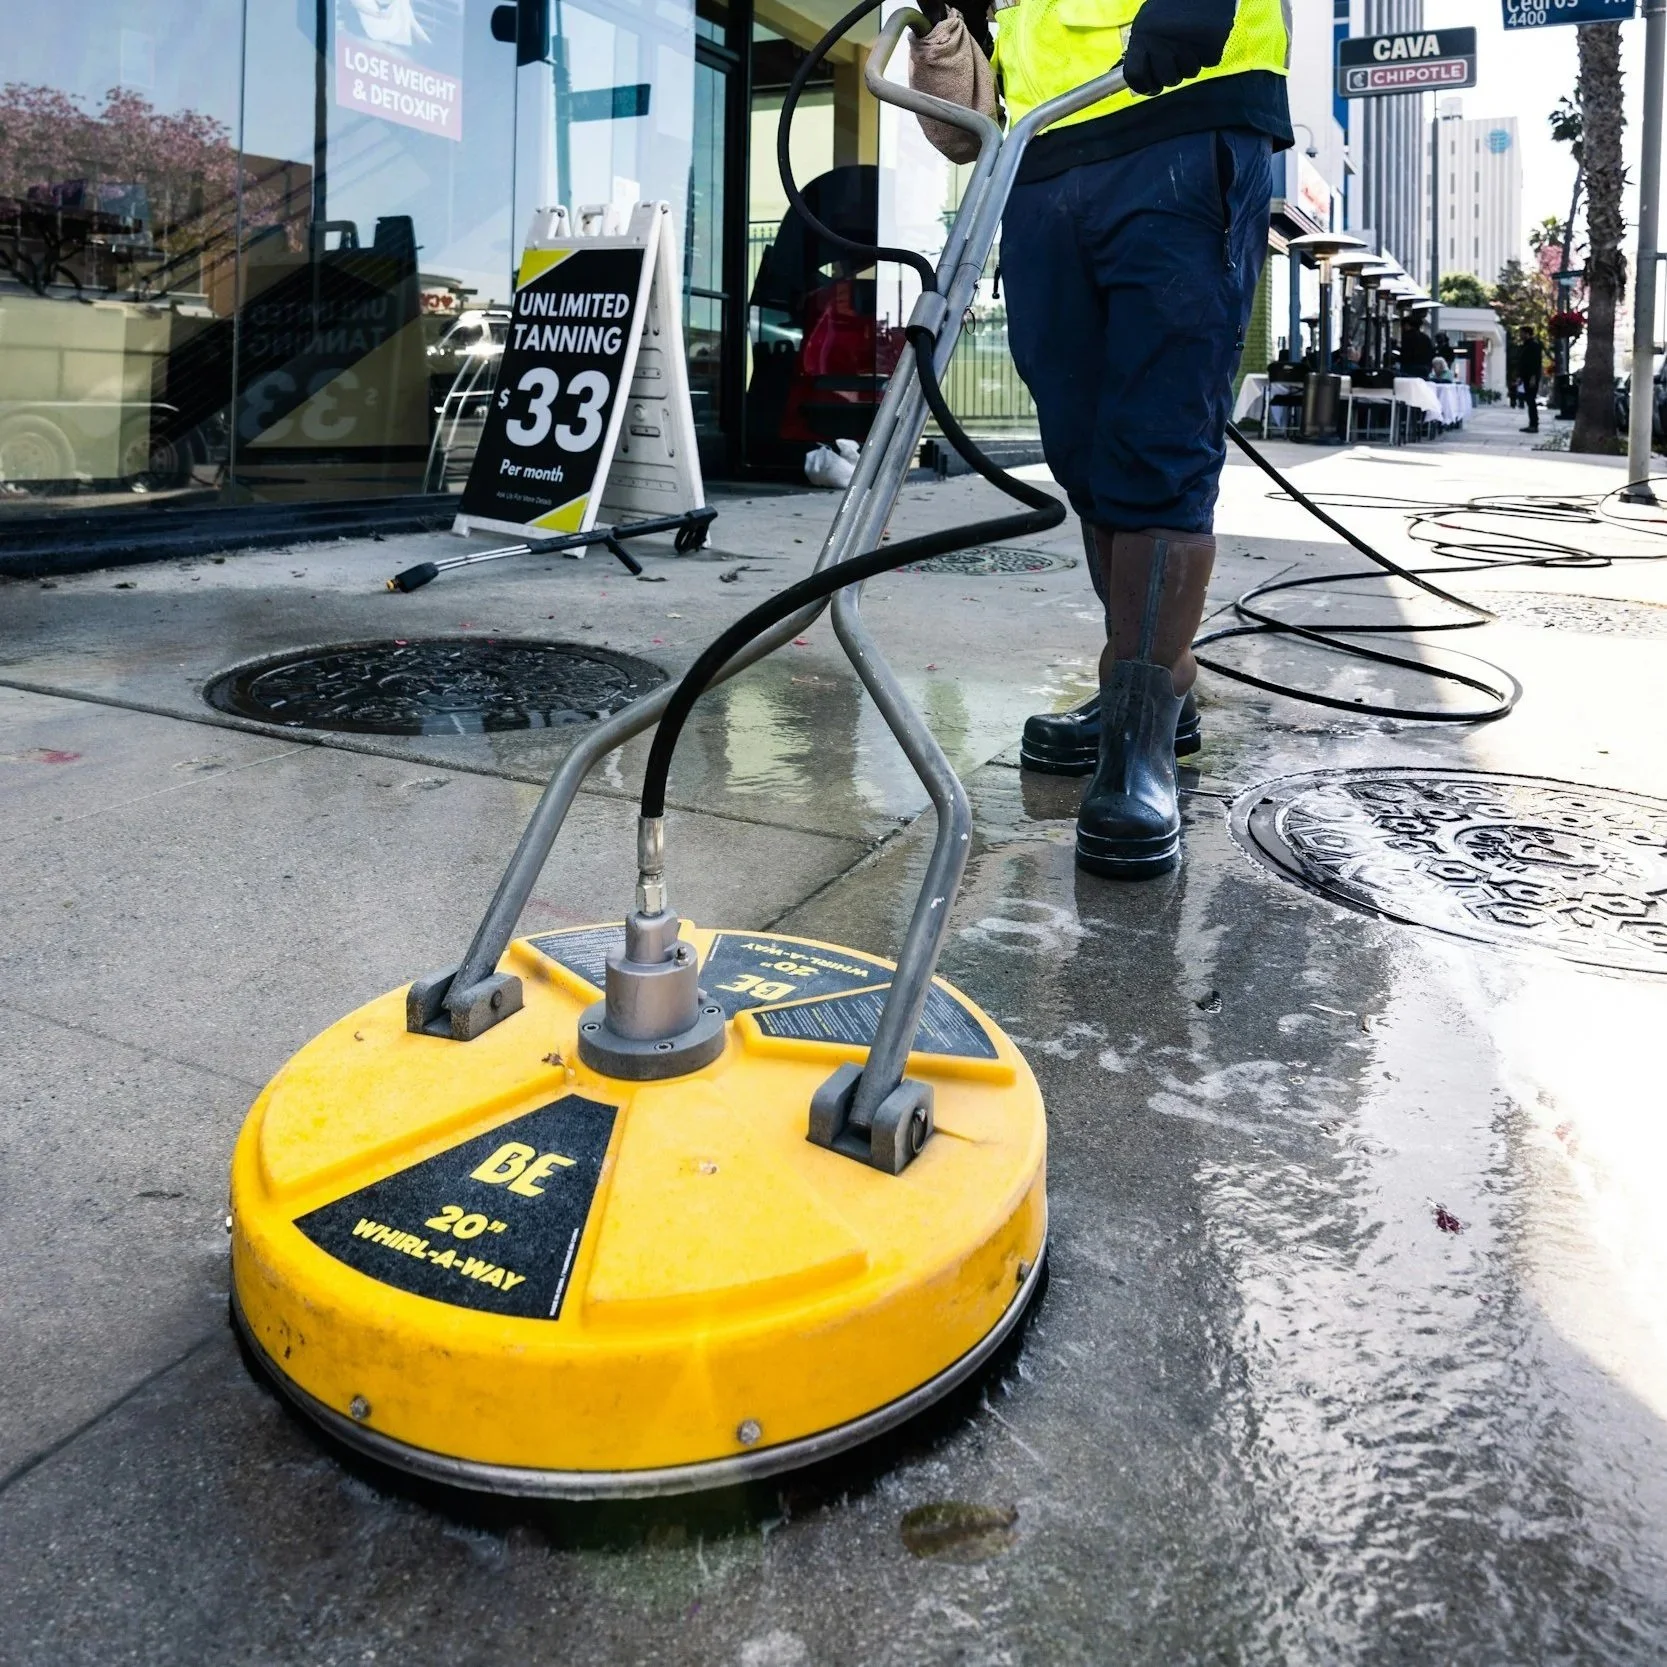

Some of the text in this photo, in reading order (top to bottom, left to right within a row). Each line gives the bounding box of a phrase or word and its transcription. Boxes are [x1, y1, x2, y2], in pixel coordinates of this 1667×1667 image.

[1508, 10, 1547, 26] 4400
[1373, 34, 1440, 61] CAVA
[344, 47, 456, 103] LOSE WEIGHT
[1373, 65, 1462, 84] CHIPOTLE
[352, 78, 451, 127] & DETOXIFY
[519, 292, 630, 319] UNLIMITED
[514, 323, 622, 355] TANNING
[500, 459, 564, 482] Per month
[740, 942, 869, 978] WHIRL-A-WAY
[715, 973, 797, 1000] BE
[469, 1141, 577, 1197] BE
[424, 1205, 508, 1240] 20"
[352, 1218, 526, 1291] WHIRL-A-WAY
